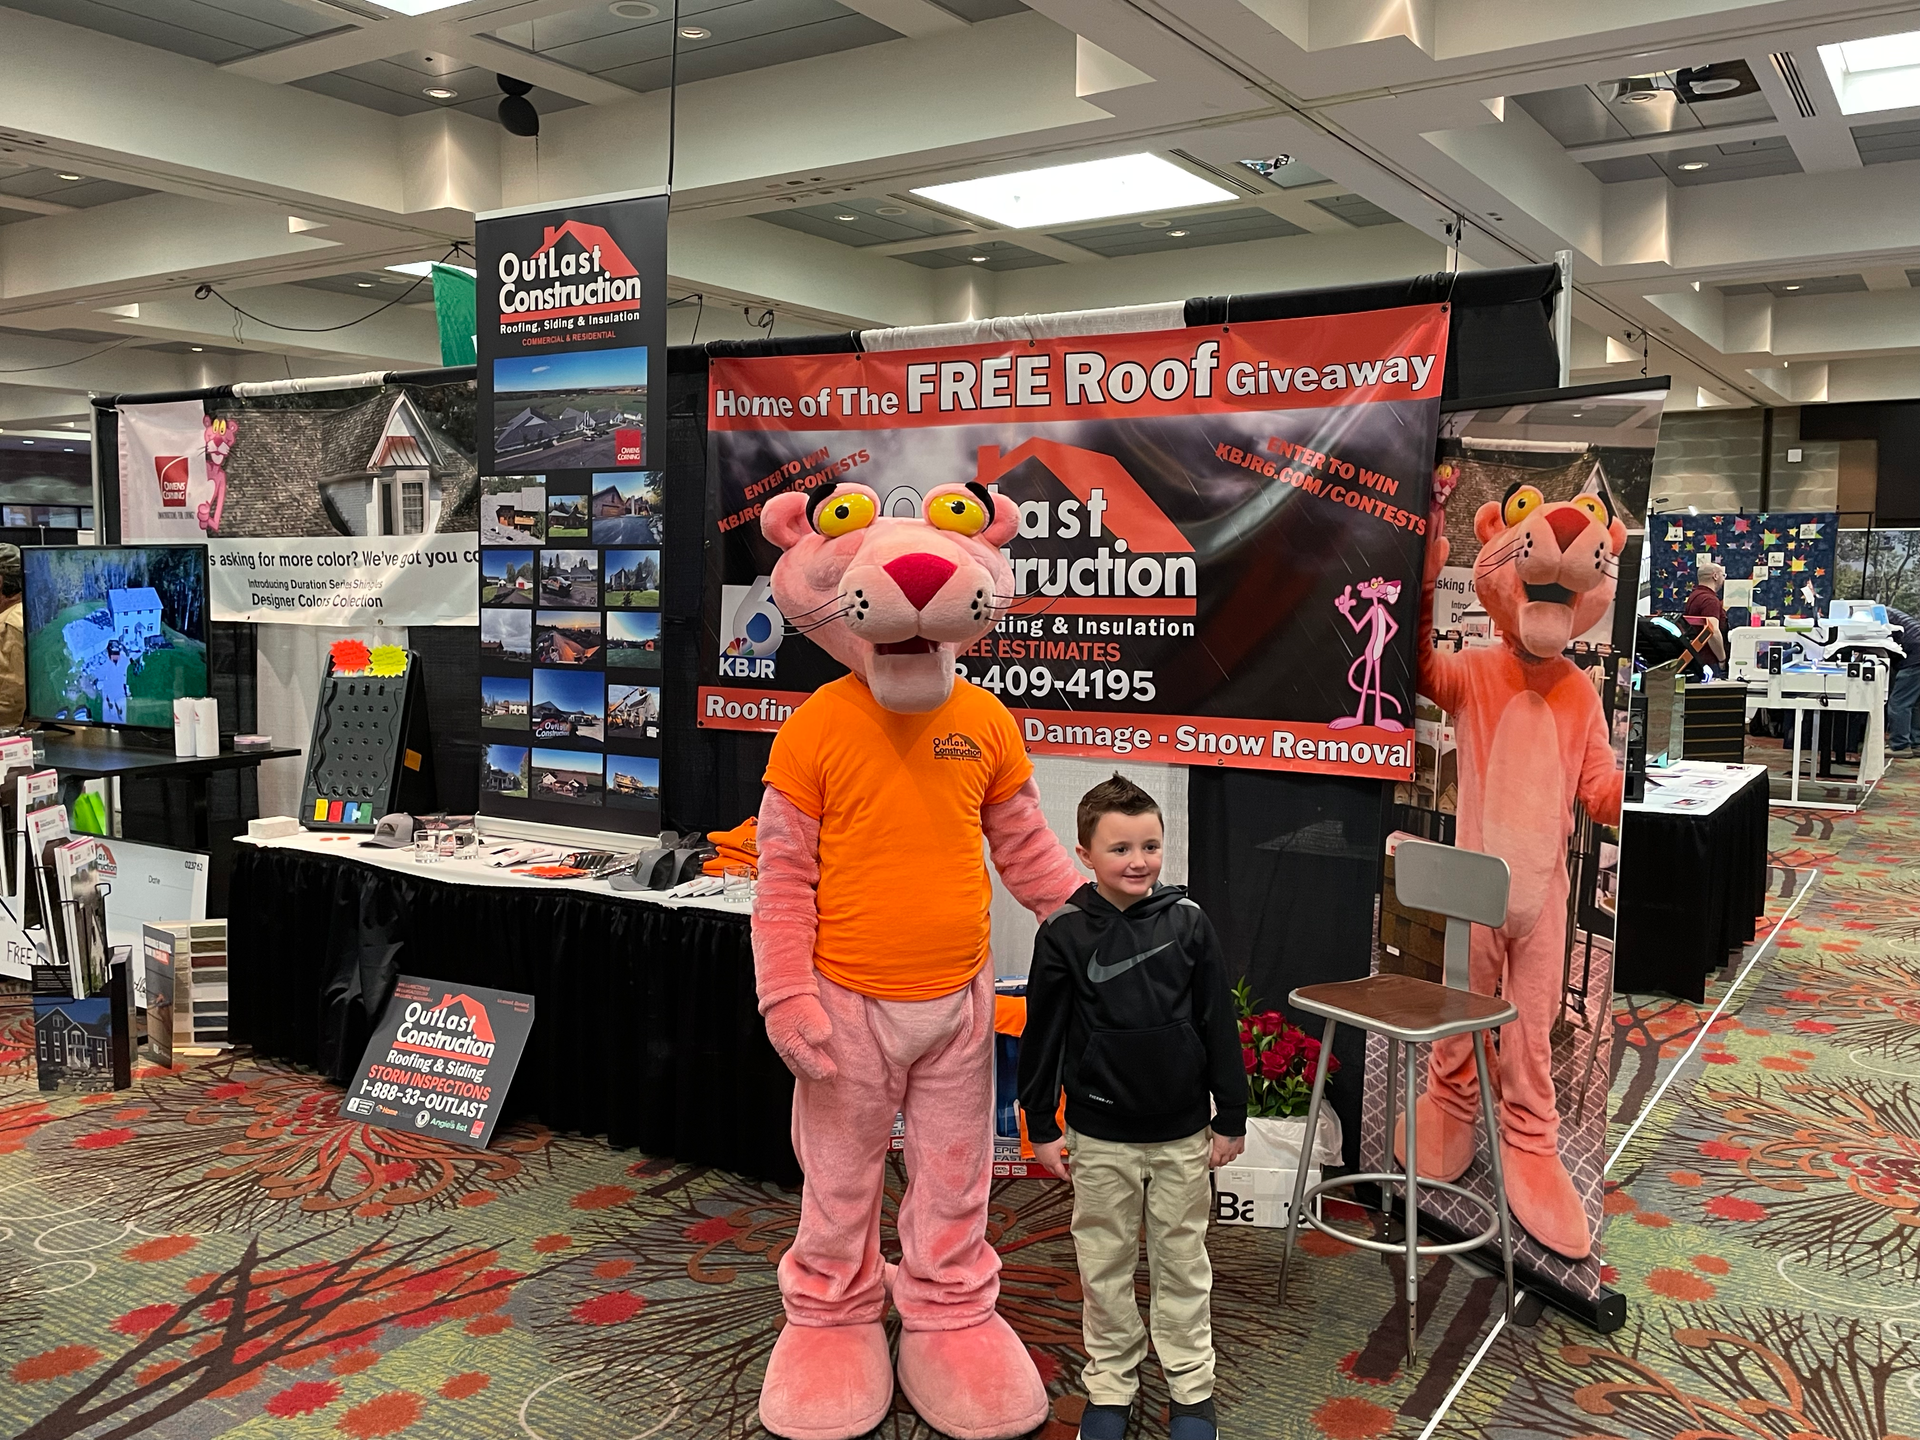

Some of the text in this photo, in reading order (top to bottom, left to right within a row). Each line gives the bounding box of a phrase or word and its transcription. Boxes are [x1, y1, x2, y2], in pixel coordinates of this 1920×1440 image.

[499, 245, 601, 283] OutLast
[499, 271, 640, 314] Construction
[500, 311, 640, 334] Roofing, Siding & Insulation
[522, 337, 564, 346] COMMERCIAL
[572, 330, 616, 341] RESIDENTIAL
[715, 340, 1436, 418] Home of The FREE Roof Giveaway
[743, 446, 830, 500] ENTER TO WIN
[1267, 436, 1399, 496] ENTER TO WIN
[163, 482, 186, 490] OWENS
[1215, 442, 1427, 536] KBJR6.COM/CONTESTS
[220, 551, 255, 570] asking
[258, 551, 275, 566] for
[279, 554, 313, 567] more
[317, 551, 358, 567] color?
[362, 550, 399, 567] We've
[400, 550, 421, 568] got
[425, 550, 457, 567] you
[247, 578, 383, 591] Introducing Duration Series Shingles
[252, 593, 295, 609] Designer
[298, 594, 331, 608] Colors
[995, 616, 1195, 638] ding & Insulation
[998, 640, 1121, 662] ESTIMATES
[718, 657, 775, 679] KBJR
[705, 694, 800, 722] Roofin
[933, 737, 967, 747] OutLast
[933, 745, 982, 757] Construction
[1024, 717, 1152, 753] Damage
[1175, 725, 1265, 757] Snow
[1271, 730, 1412, 768] Removal
[148, 875, 160, 885] Date
[7, 941, 34, 966] FREE
[405, 1001, 477, 1032] OutLast
[396, 1022, 495, 1059] Construction
[386, 1049, 486, 1083] Roofing & Siding
[368, 1064, 491, 1101] STORM INSPECTIONS
[359, 1079, 488, 1119] 1-888-33-OUTLAST
